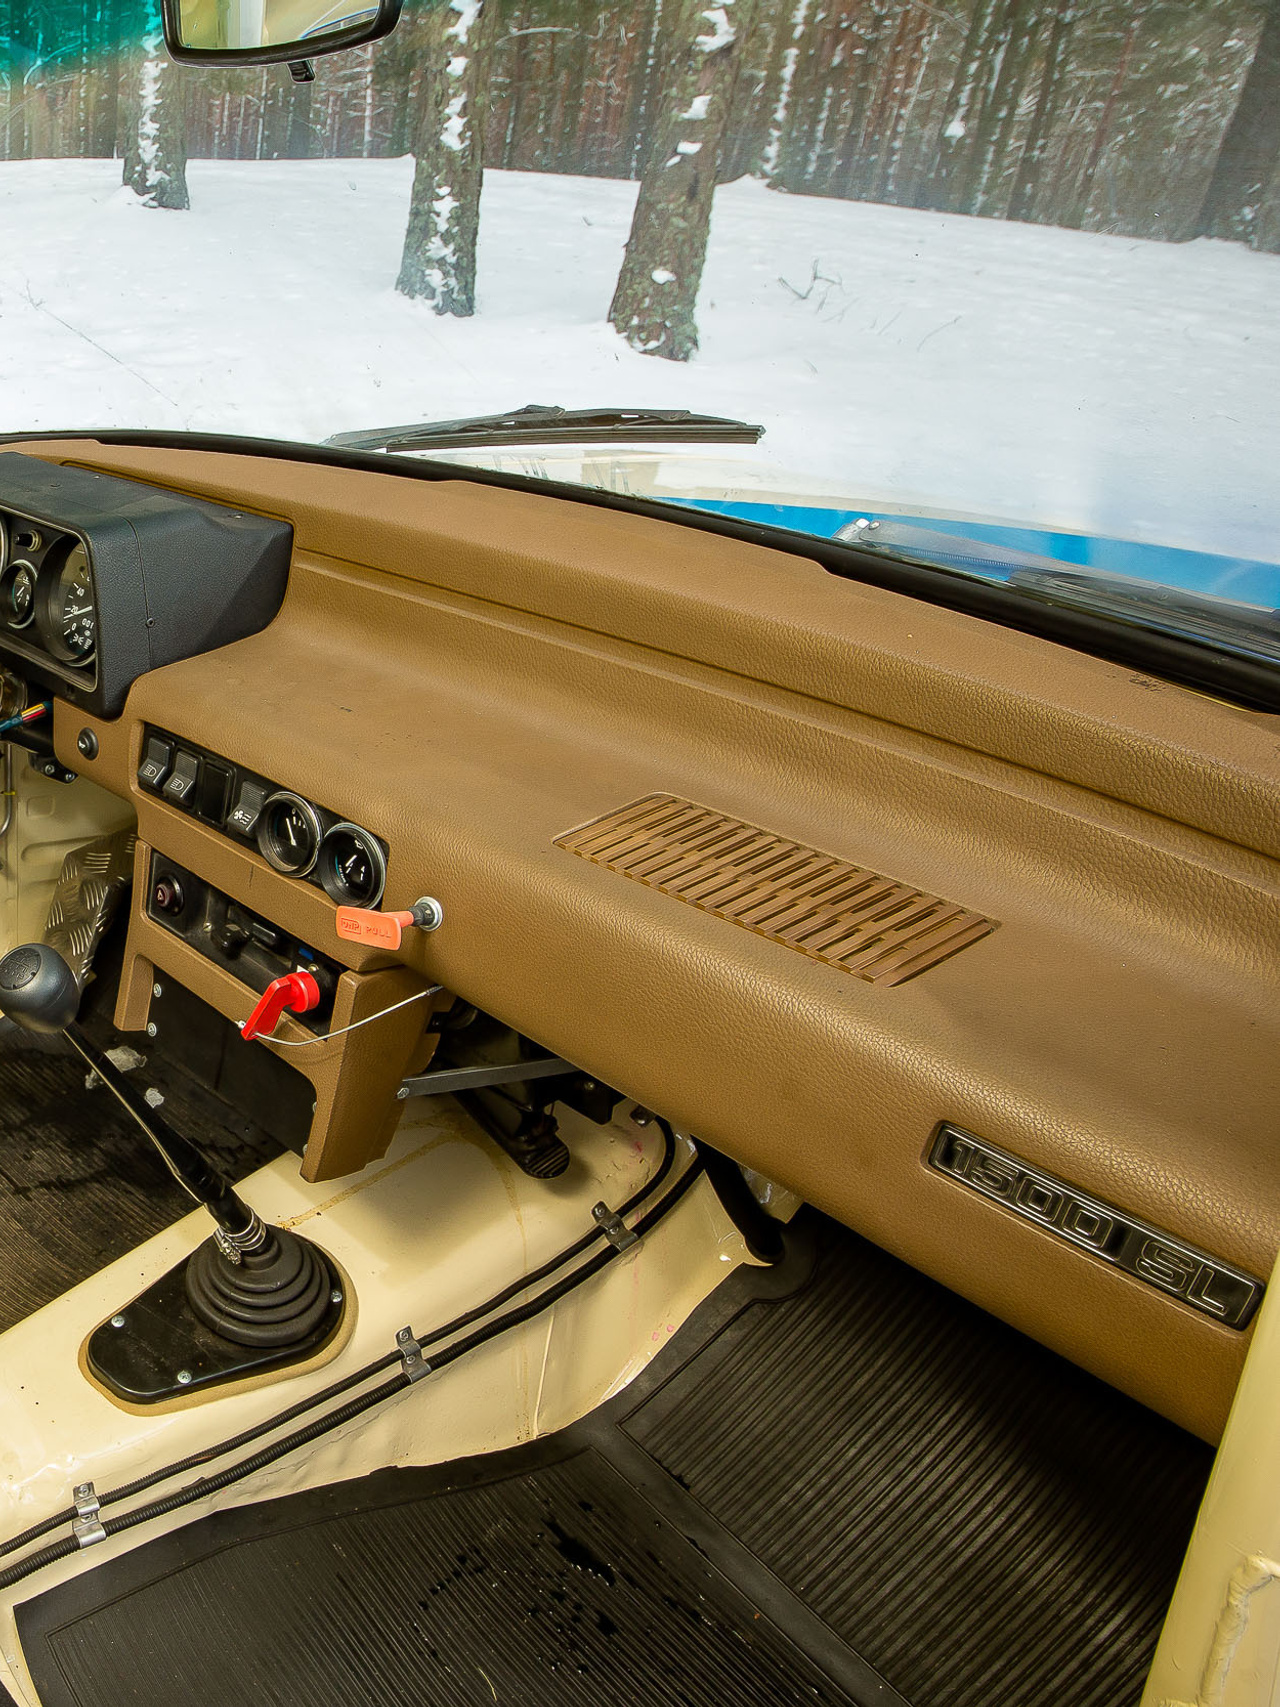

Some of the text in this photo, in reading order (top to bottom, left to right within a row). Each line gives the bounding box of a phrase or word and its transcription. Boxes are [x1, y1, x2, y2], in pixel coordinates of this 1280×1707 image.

[366, 926, 392, 939] PULL
[951, 1140, 1228, 1317] 1500 SL
